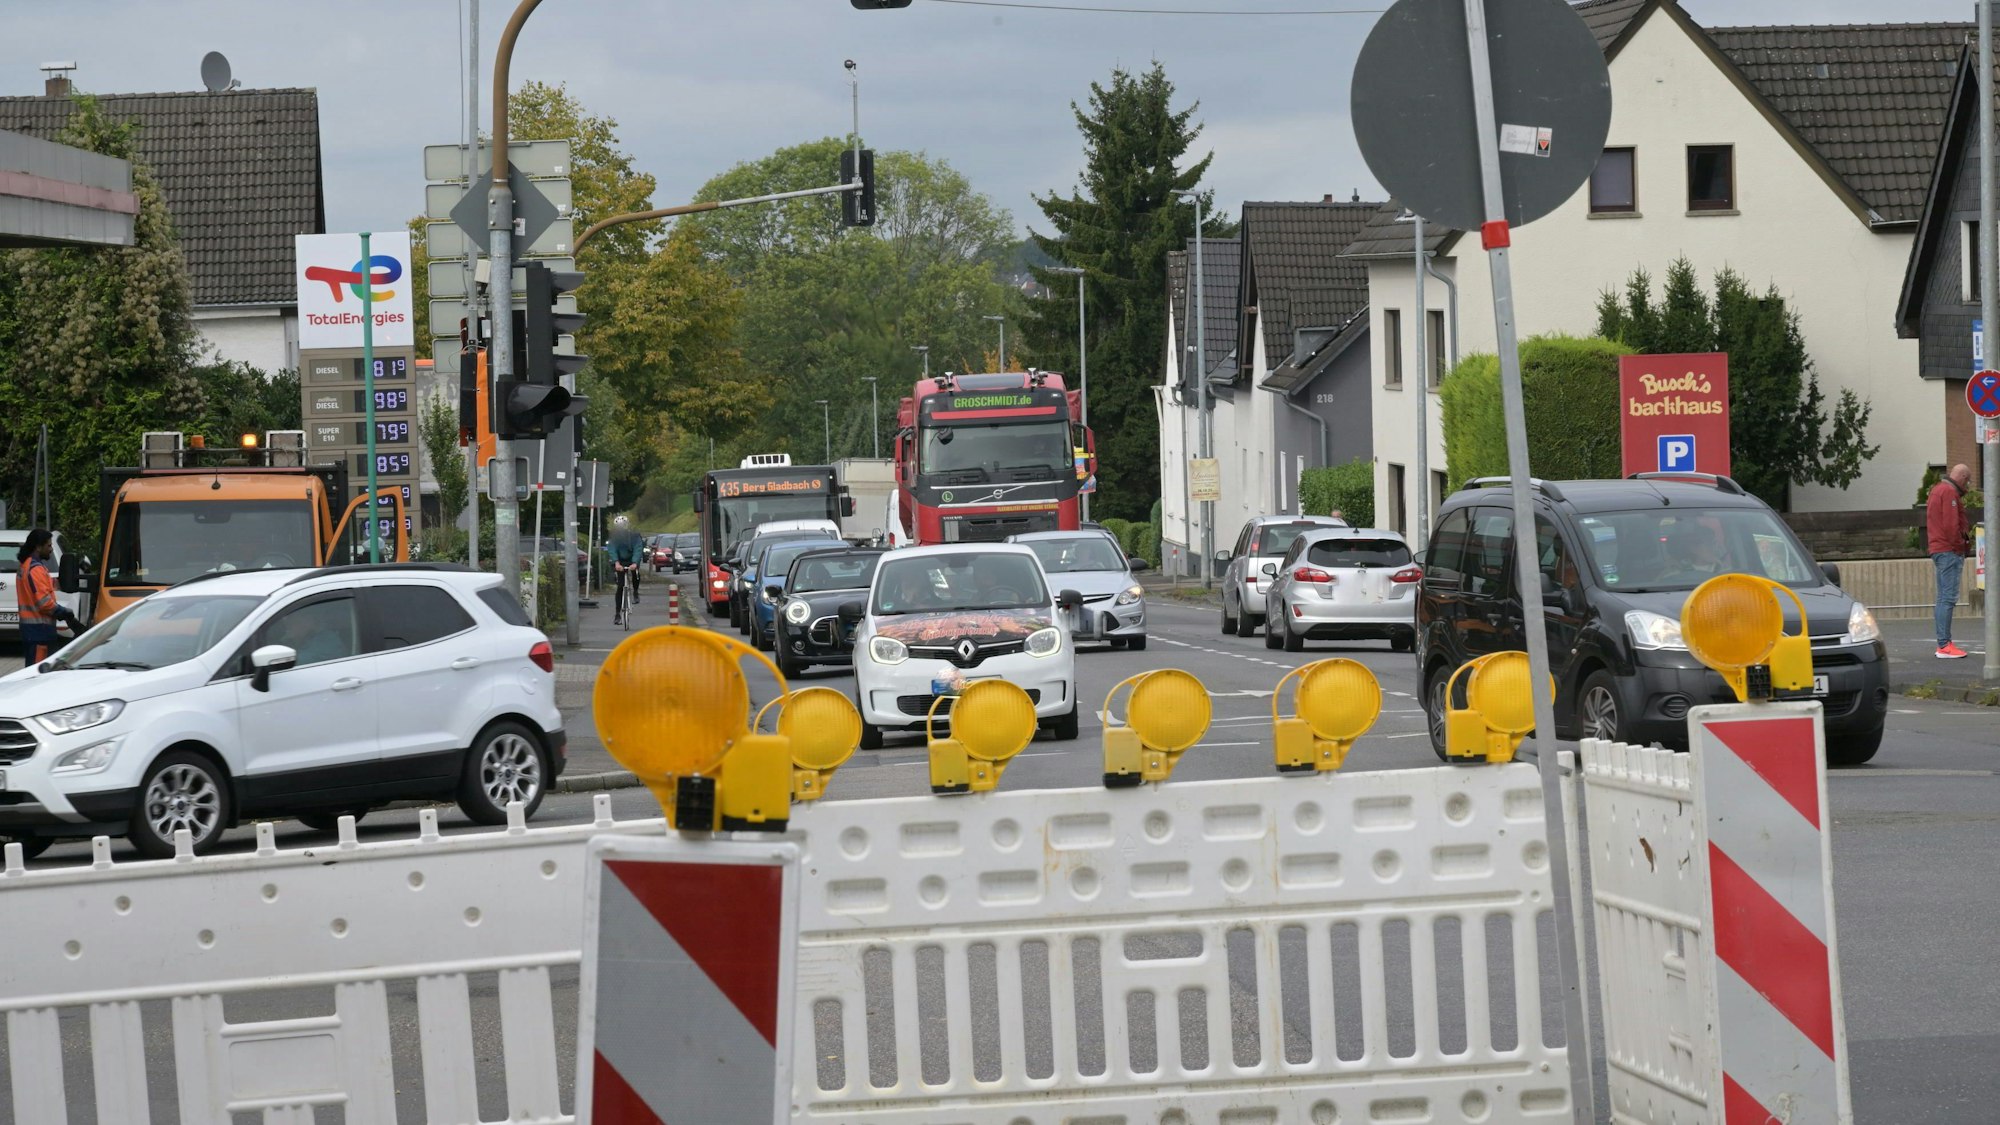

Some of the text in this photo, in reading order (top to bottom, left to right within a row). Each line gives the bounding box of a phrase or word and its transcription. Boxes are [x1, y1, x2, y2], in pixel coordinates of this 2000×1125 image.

[1639, 371, 1711, 395] Busch's
[954, 395, 1032, 408] GROSCHMIDT.de
[1316, 393, 1334, 403] 218
[1629, 395, 1723, 416] backhaus
[1666, 441, 1689, 467] P
[720, 481, 740, 497] 435
[742, 483, 766, 492] Berg
[767, 480, 810, 491] Gladbach
